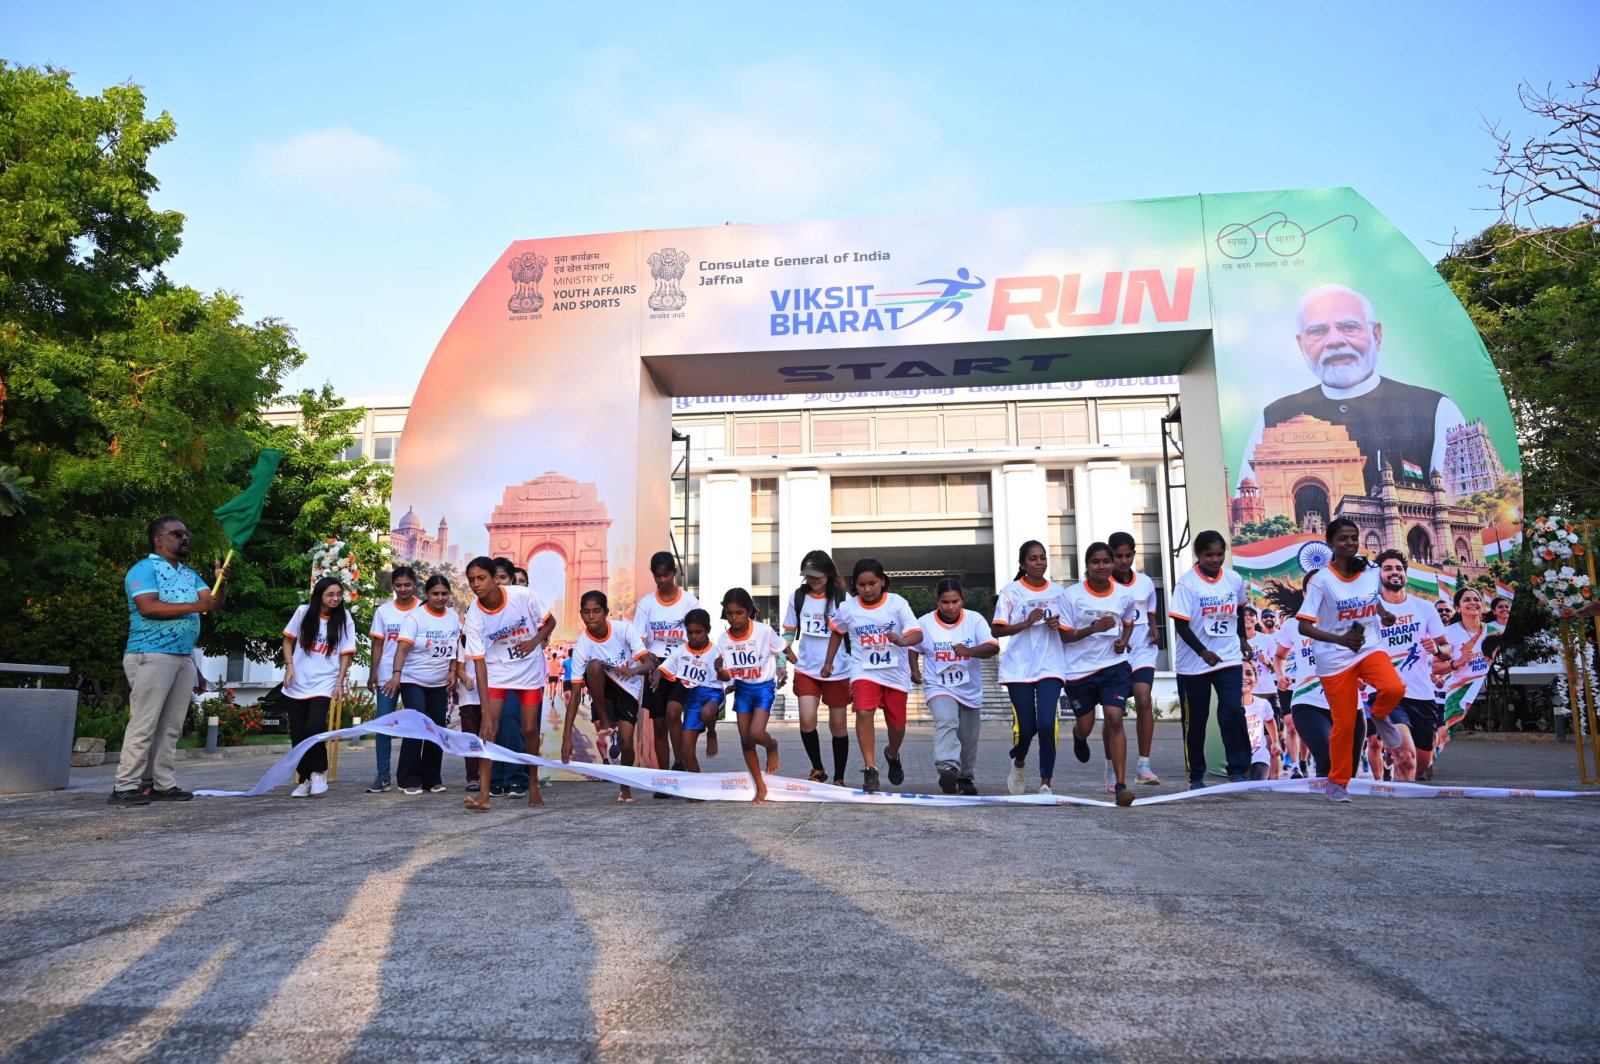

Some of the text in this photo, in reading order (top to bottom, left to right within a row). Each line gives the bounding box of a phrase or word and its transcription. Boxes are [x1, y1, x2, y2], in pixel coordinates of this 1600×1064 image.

[1275, 235, 1295, 244] भारत
[554, 252, 600, 265] युवा कार्यक्रम
[699, 251, 891, 271] Consulate General of India
[554, 262, 610, 274] एवं खेल मंत्रालय
[553, 274, 615, 286] MINISTRY OF
[698, 274, 743, 286] Jaffna
[553, 285, 637, 299] YOUTH AFFAIRS
[770, 285, 874, 312] VIKSIT
[552, 298, 620, 312] AND SPORTS
[987, 267, 1196, 332] RUN
[770, 308, 904, 336] BHARAT
[777, 353, 1072, 384] START
[1293, 432, 1317, 442] INDIA
[538, 490, 562, 498] INDIA
[1336, 597, 1358, 606] VIKSIT
[1336, 601, 1366, 611] BHARAT
[1338, 604, 1377, 621] RUN
[805, 620, 829, 634] 124
[1210, 620, 1230, 634] 45
[1381, 622, 1420, 638] BHARAT
[1388, 633, 1412, 646] RUN
[432, 646, 453, 658] 292
[664, 644, 678, 656] 5
[731, 650, 756, 666] 106
[870, 650, 892, 666] 04
[682, 664, 707, 682] 108
[1472, 662, 1488, 672] RUN
[941, 670, 964, 685] 119
